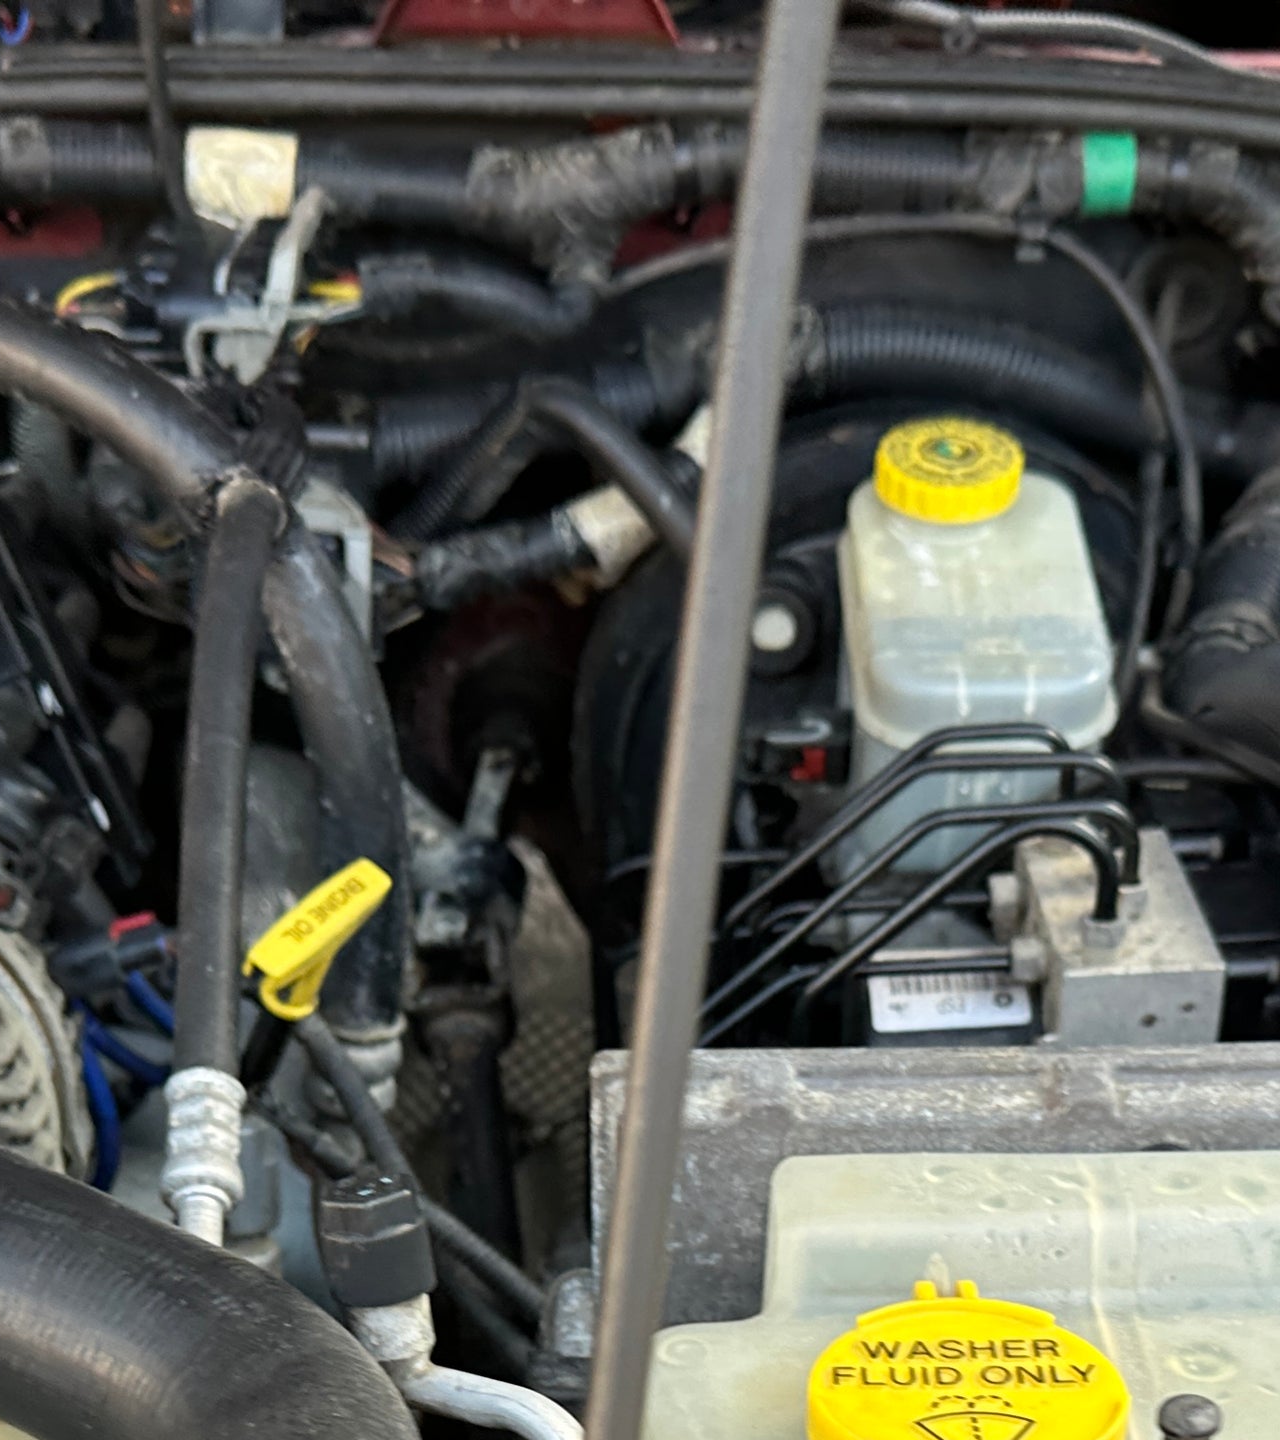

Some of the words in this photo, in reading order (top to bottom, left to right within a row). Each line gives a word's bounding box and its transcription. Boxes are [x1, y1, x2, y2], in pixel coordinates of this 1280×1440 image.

[307, 876, 368, 924] ENGINE
[280, 918, 315, 944] OIL
[858, 1338, 1062, 1361] WASHER
[831, 1365, 963, 1387] FLUID
[979, 1364, 1097, 1386] ONLY
